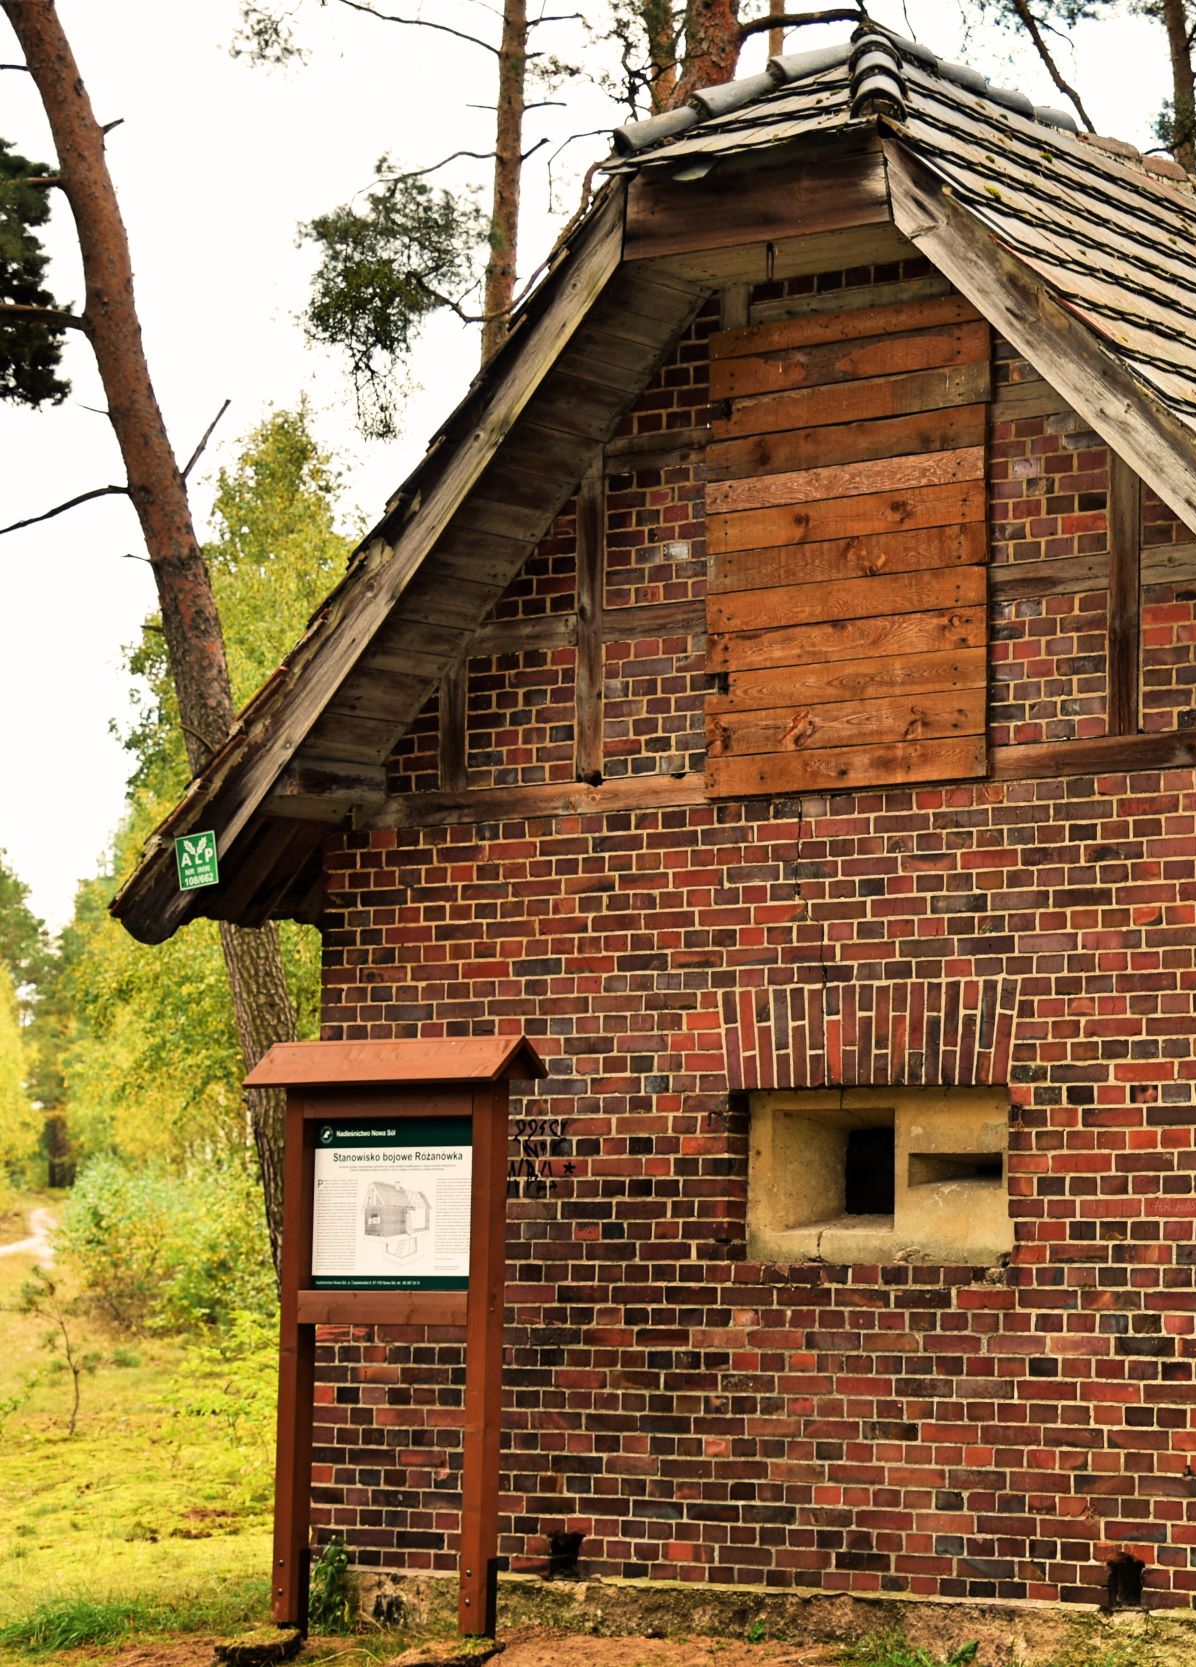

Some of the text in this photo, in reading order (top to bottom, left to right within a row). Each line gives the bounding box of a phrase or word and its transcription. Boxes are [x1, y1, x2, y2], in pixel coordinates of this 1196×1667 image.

[181, 847, 214, 868] ALP
[336, 1129, 371, 1137] Nadleśnictwo
[371, 1129, 387, 1137] Nowa
[333, 1151, 463, 1163] Stanowisko bojowe Różanówka
